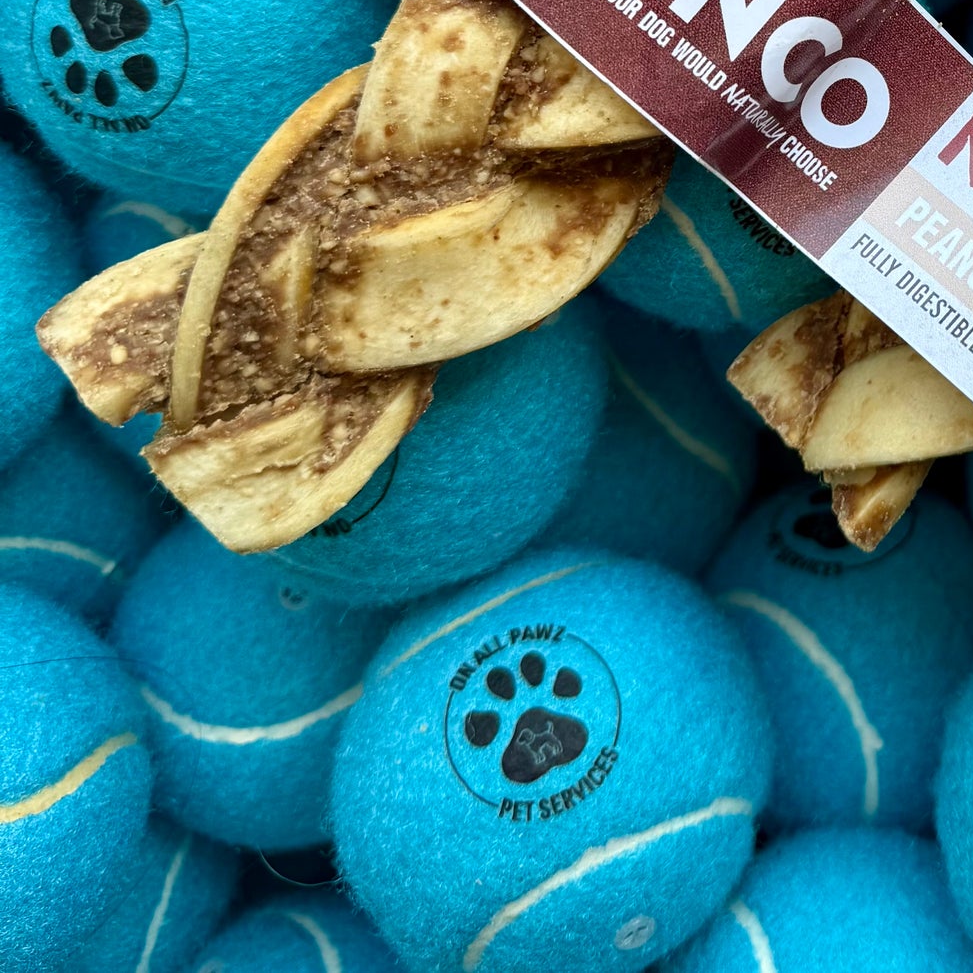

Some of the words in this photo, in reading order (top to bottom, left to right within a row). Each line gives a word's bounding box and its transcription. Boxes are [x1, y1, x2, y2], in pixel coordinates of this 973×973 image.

[638, 10, 676, 47] DOG
[671, 37, 727, 91] WOULD
[723, 83, 787, 149] NATURALLY
[779, 135, 838, 191] CHOOSE
[850, 233, 903, 280] FULLY
[450, 662, 476, 691] ON
[473, 634, 508, 665] ALL
[509, 624, 567, 644] PAWZ
[498, 798, 535, 822] PET
[539, 746, 618, 820] SERVICES
